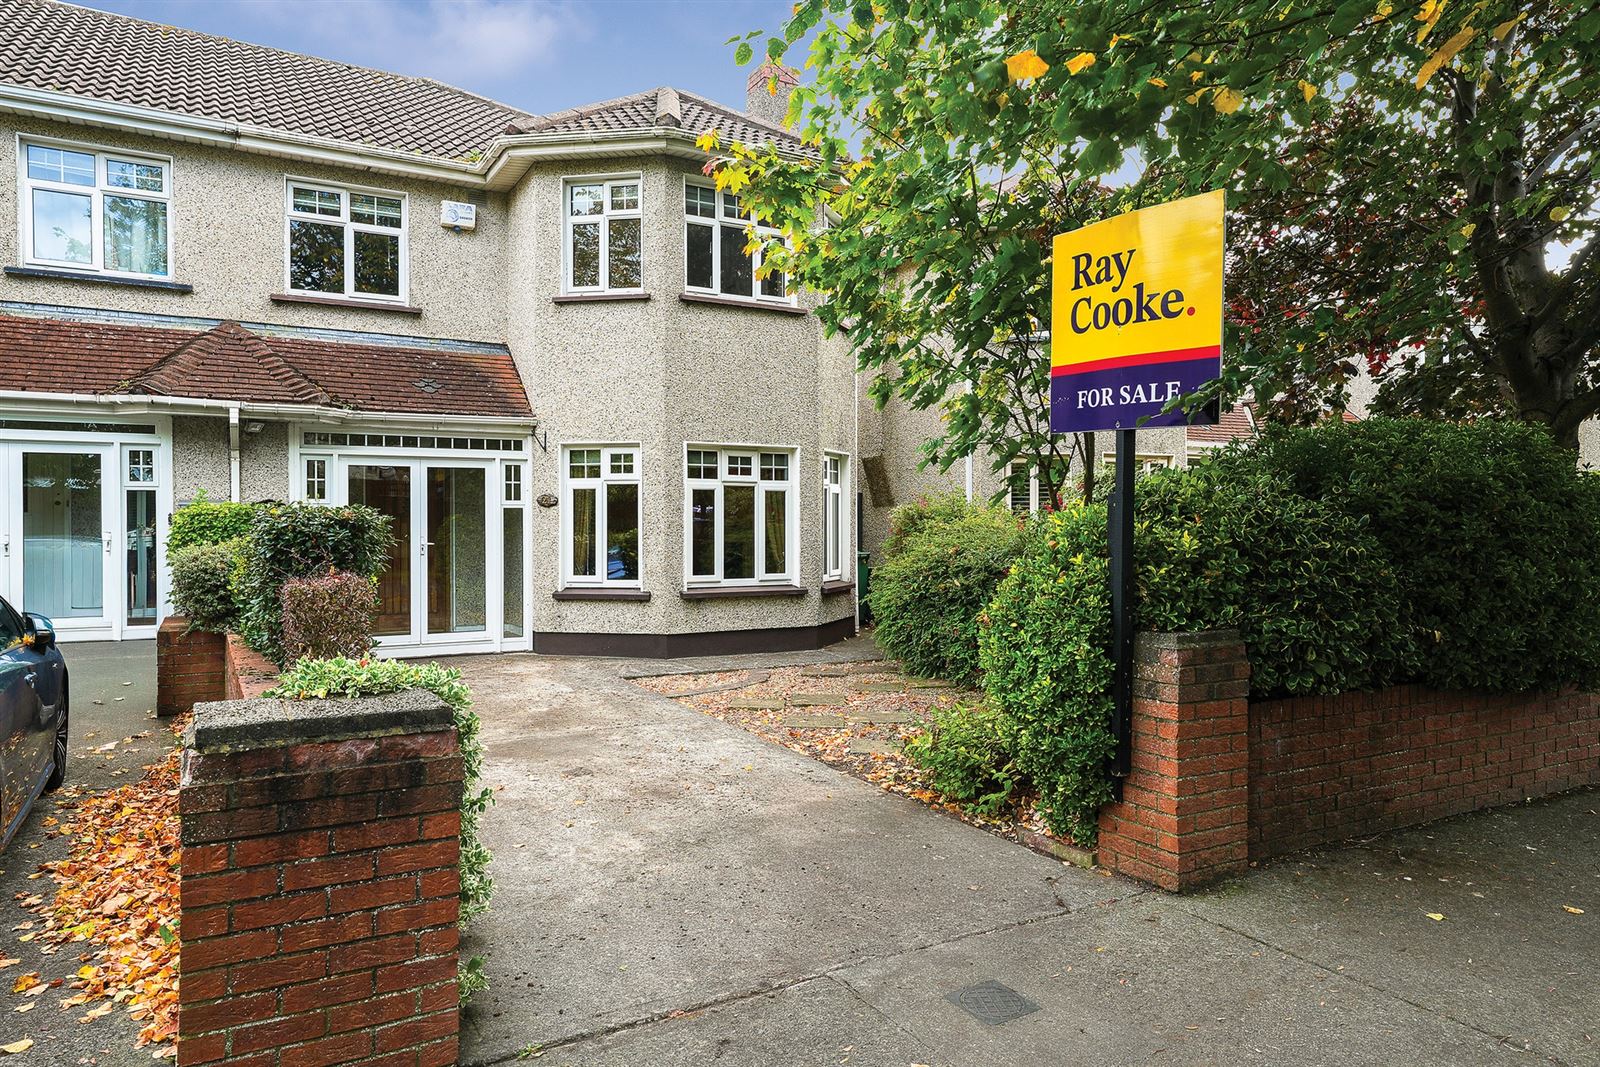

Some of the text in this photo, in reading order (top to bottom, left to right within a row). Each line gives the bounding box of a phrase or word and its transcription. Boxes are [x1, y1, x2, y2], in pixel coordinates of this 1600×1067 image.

[1071, 249, 1137, 293] Ray
[1071, 282, 1196, 334] Cooke.
[1077, 381, 1181, 409] FOR SALE
